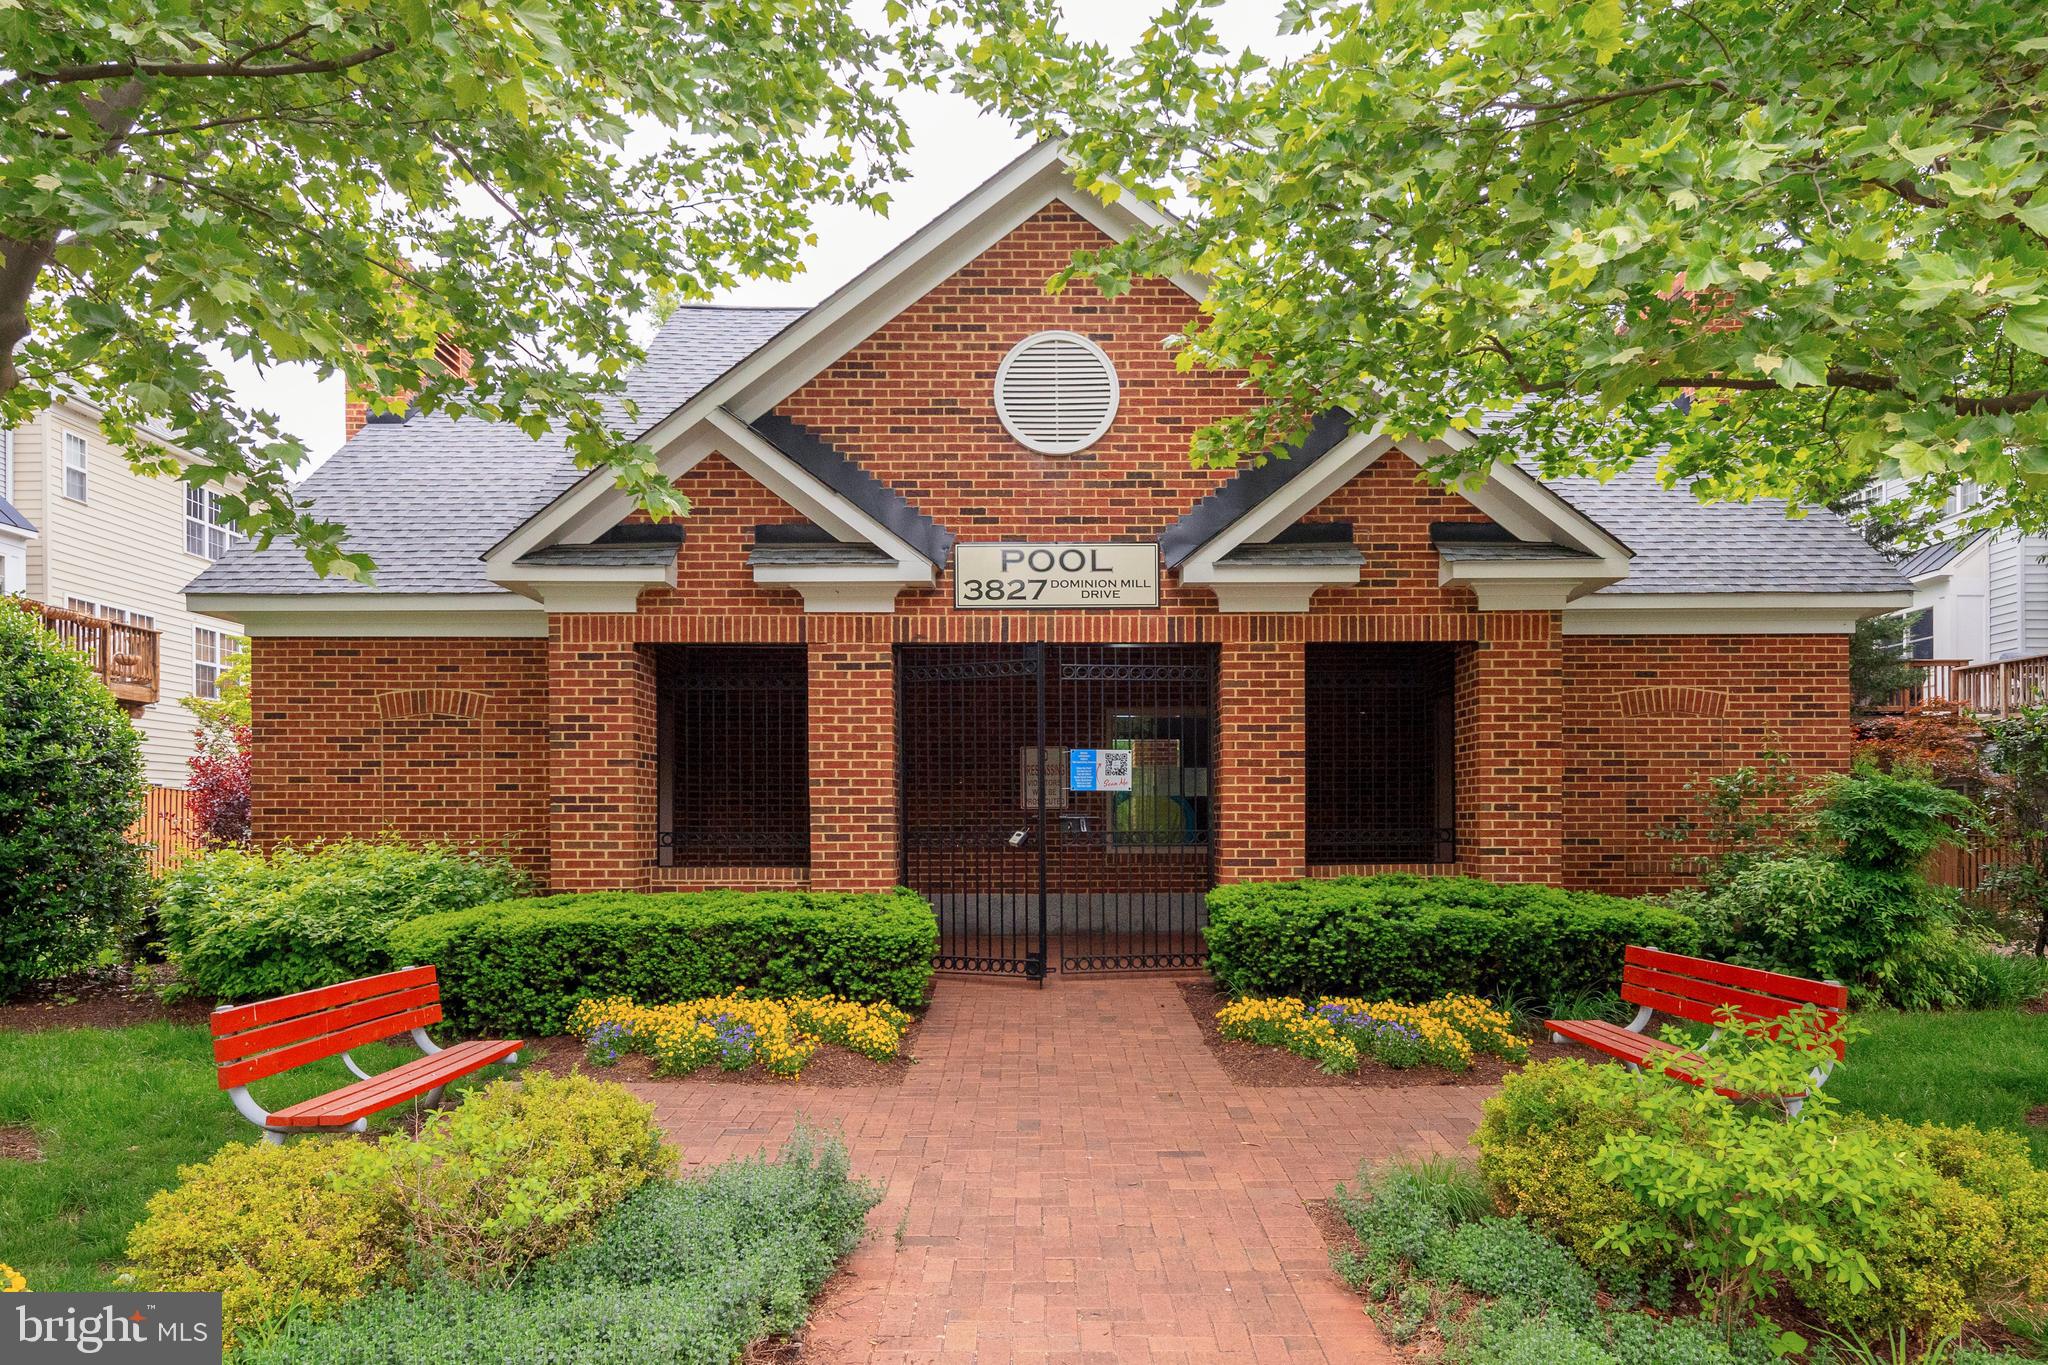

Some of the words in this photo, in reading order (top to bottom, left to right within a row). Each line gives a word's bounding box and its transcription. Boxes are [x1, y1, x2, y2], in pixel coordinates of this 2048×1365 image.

[1001, 549, 1113, 573] POOL
[963, 579, 1047, 601] 3827
[1051, 579, 1117, 588] DOMINION
[1120, 579, 1151, 588] MILL
[1081, 590, 1120, 599] DRIVE
